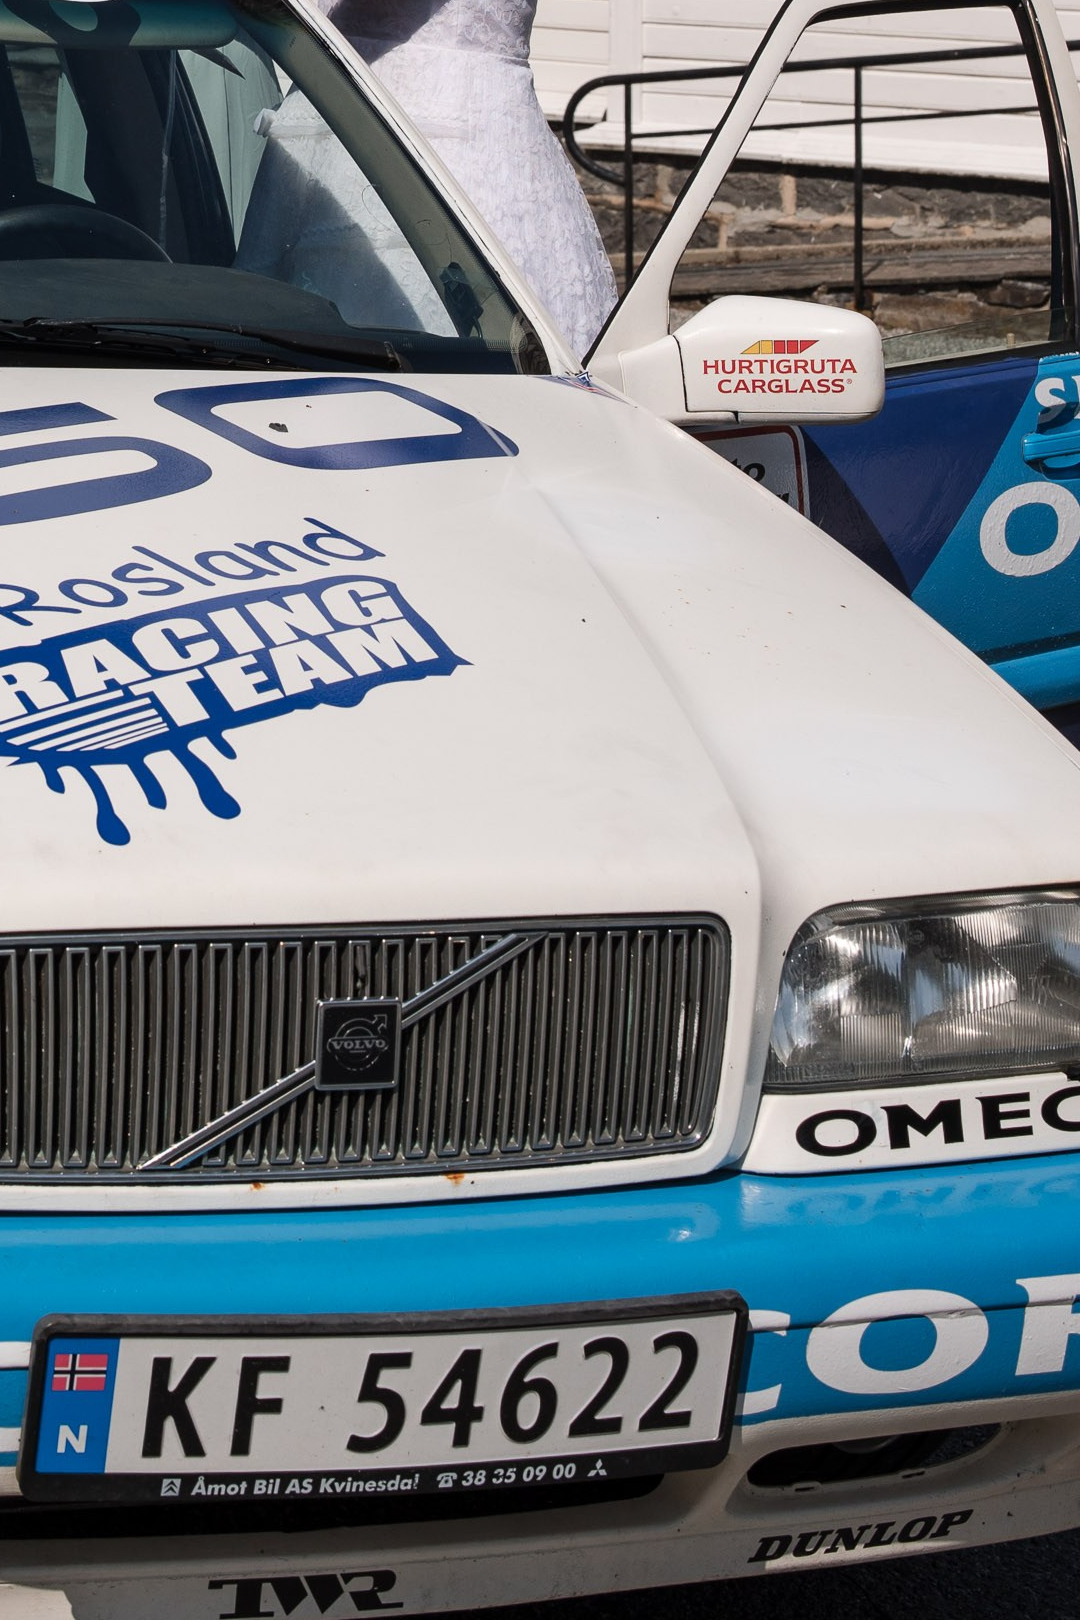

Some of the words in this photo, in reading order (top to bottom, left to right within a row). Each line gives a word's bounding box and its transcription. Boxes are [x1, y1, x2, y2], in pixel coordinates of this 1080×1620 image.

[703, 358, 858, 375] HURTIGRUTA
[126, 620, 439, 728] TEAM
[331, 1039, 386, 1050] VOLVO
[141, 1355, 292, 1459] KF
[346, 1331, 700, 1453] 54622
[56, 1425, 88, 1453] N
[191, 1475, 248, 1496] Åmot
[253, 1478, 281, 1495] Bil
[284, 1478, 313, 1494] AS
[320, 1473, 420, 1493] Kvinesdal
[461, 1469, 486, 1486] 38
[522, 1465, 547, 1482] 09
[552, 1463, 576, 1479] 00
[747, 1509, 975, 1563] DUNLOP
[208, 1569, 405, 1619] TWR
